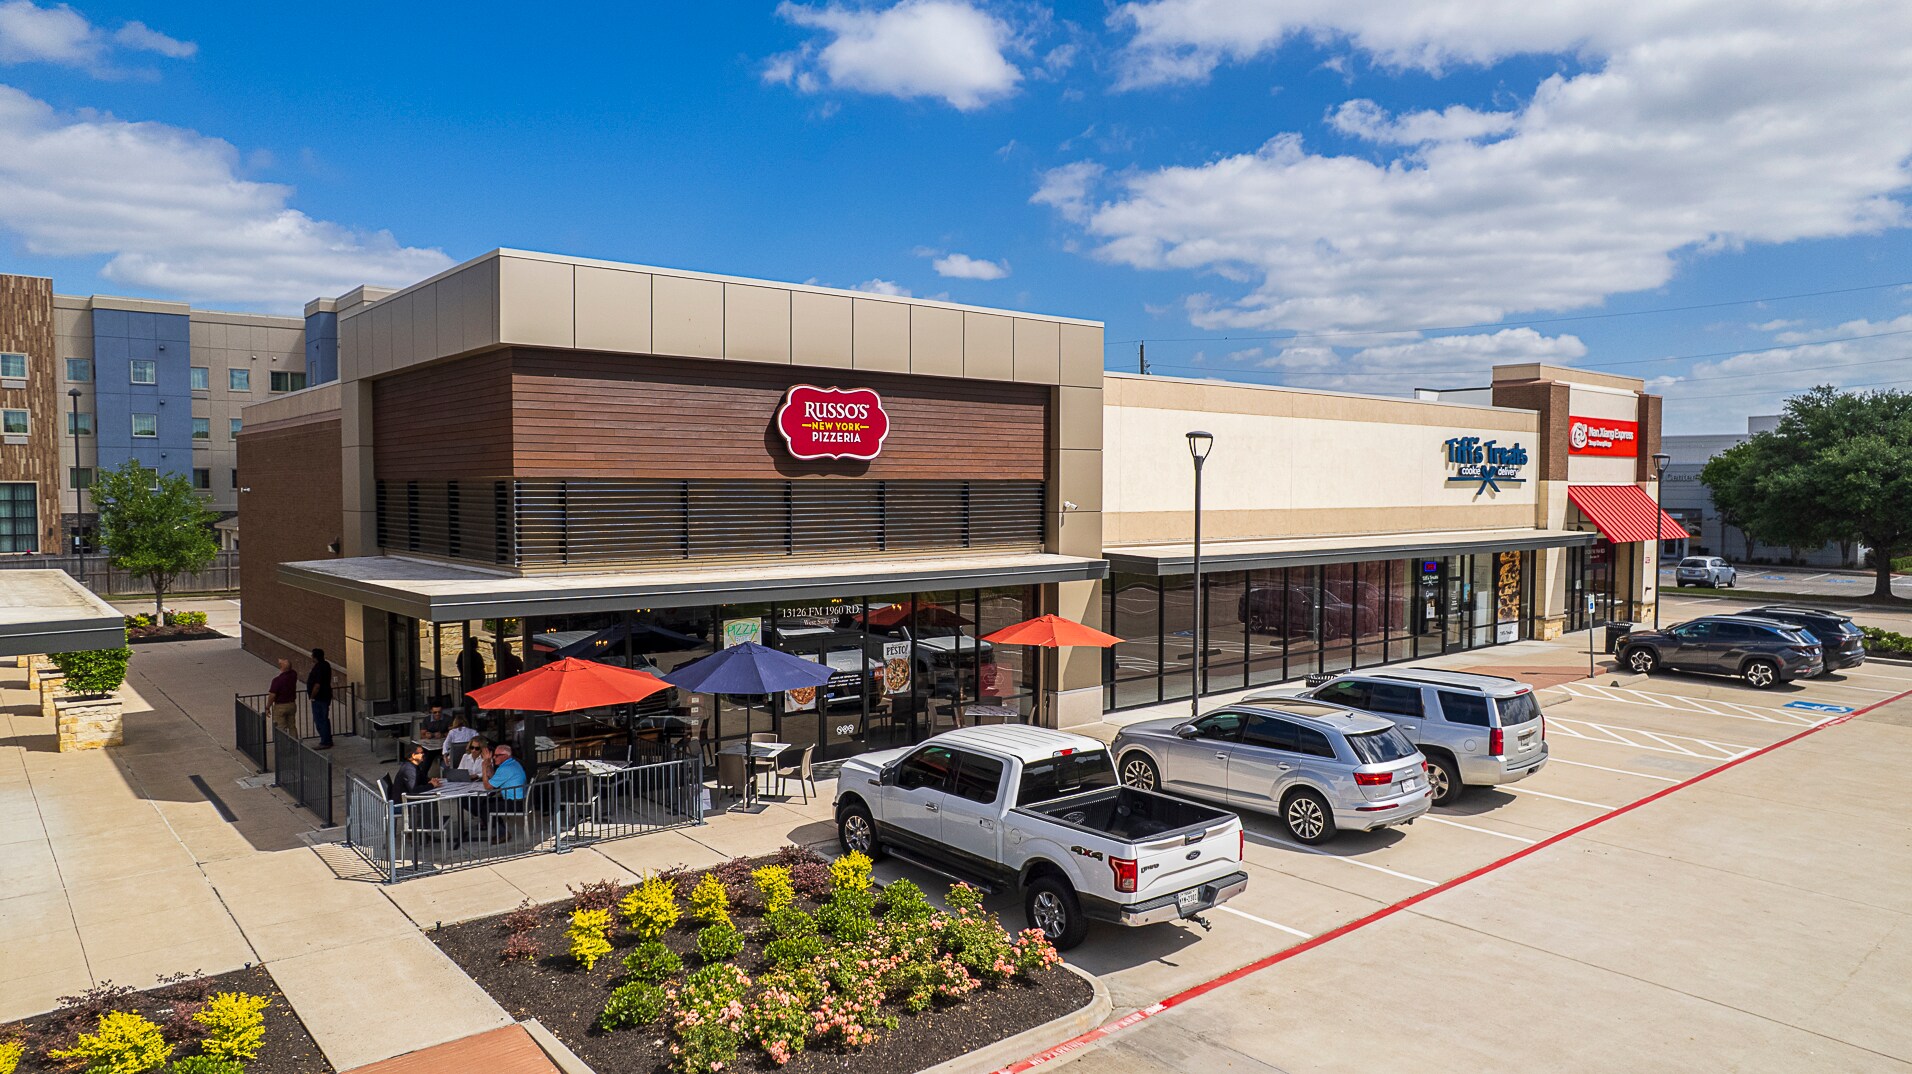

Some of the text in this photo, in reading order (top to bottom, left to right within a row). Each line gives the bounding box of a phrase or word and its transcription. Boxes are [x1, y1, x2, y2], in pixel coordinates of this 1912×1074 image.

[804, 401, 869, 421] RUSSO'S
[811, 421, 860, 431] NEW YORK
[812, 431, 861, 442] PIZZERIA
[1600, 427, 1614, 440] Xiang
[1614, 428, 1634, 440] Express
[1445, 437, 1528, 465] Tiff's Treats
[1461, 466, 1519, 477] cookie delivery
[1667, 473, 1695, 482] Center
[783, 608, 806, 618] 13126
[809, 606, 823, 616] FM
[826, 606, 843, 615] 1960
[727, 623, 757, 636] PIZZA
[1029, 1057, 1044, 1066] NO
[1046, 1041, 1085, 1060] PARKING
